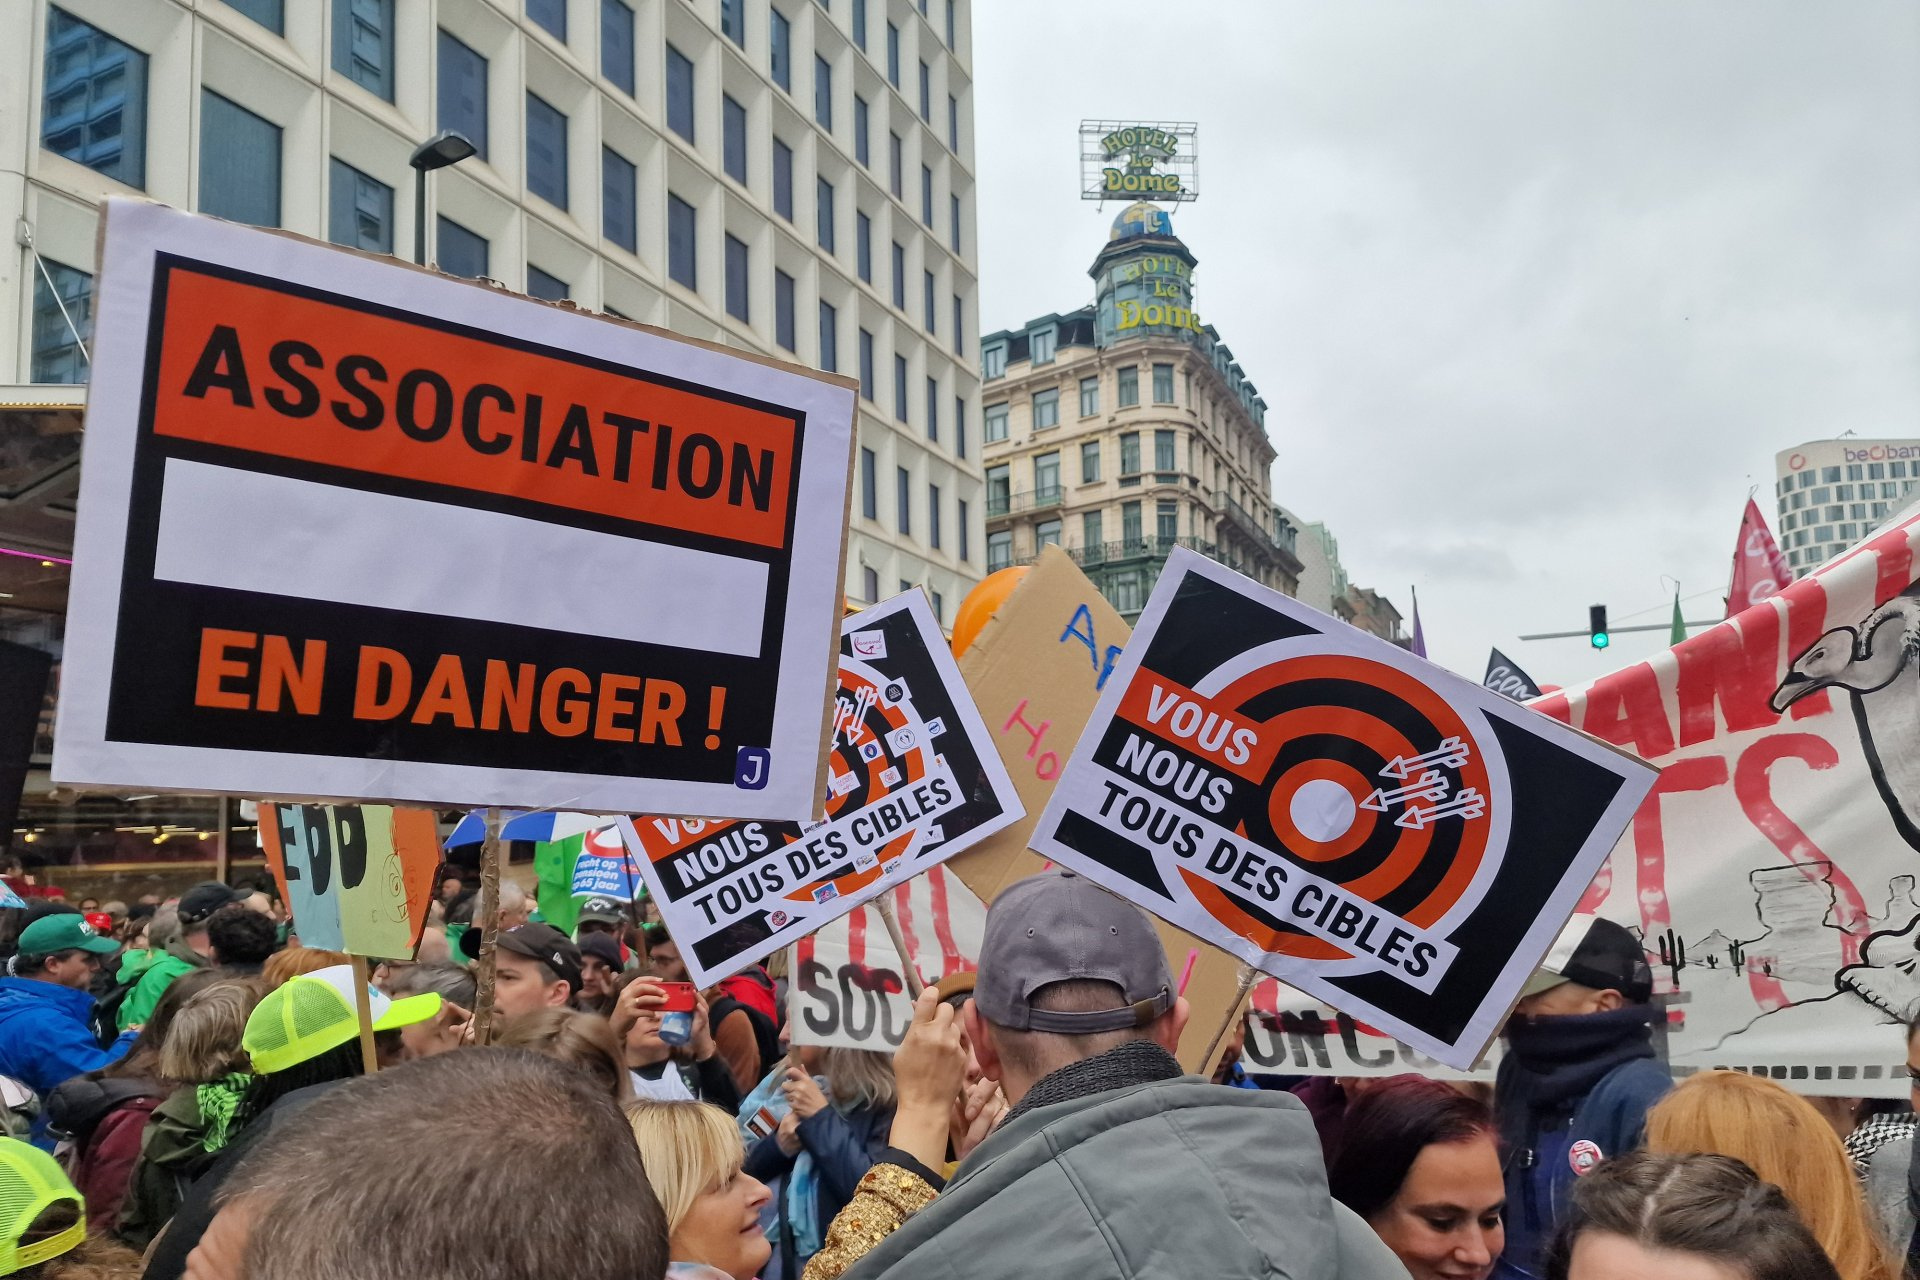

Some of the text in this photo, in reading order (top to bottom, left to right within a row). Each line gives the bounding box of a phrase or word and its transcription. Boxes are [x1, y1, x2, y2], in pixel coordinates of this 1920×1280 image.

[1101, 127, 1178, 156] HOTEL
[1130, 152, 1153, 168] Le
[1103, 168, 1179, 192] Dome
[1153, 279, 1180, 298] Le
[1116, 299, 1204, 334] Dome
[183, 323, 775, 512] ASSOCIATION
[194, 626, 728, 750] EN DANGER !
[1146, 684, 1258, 766] VOUS
[742, 755, 762, 783] J
[1115, 733, 1233, 814] NOUS
[601, 860, 617, 870] op
[673, 822, 770, 888] NOUS
[693, 777, 953, 925] TOUS DES CIBLES
[592, 879, 621, 891] jaar
[1098, 780, 1438, 978] TOUS DES CIBLES
